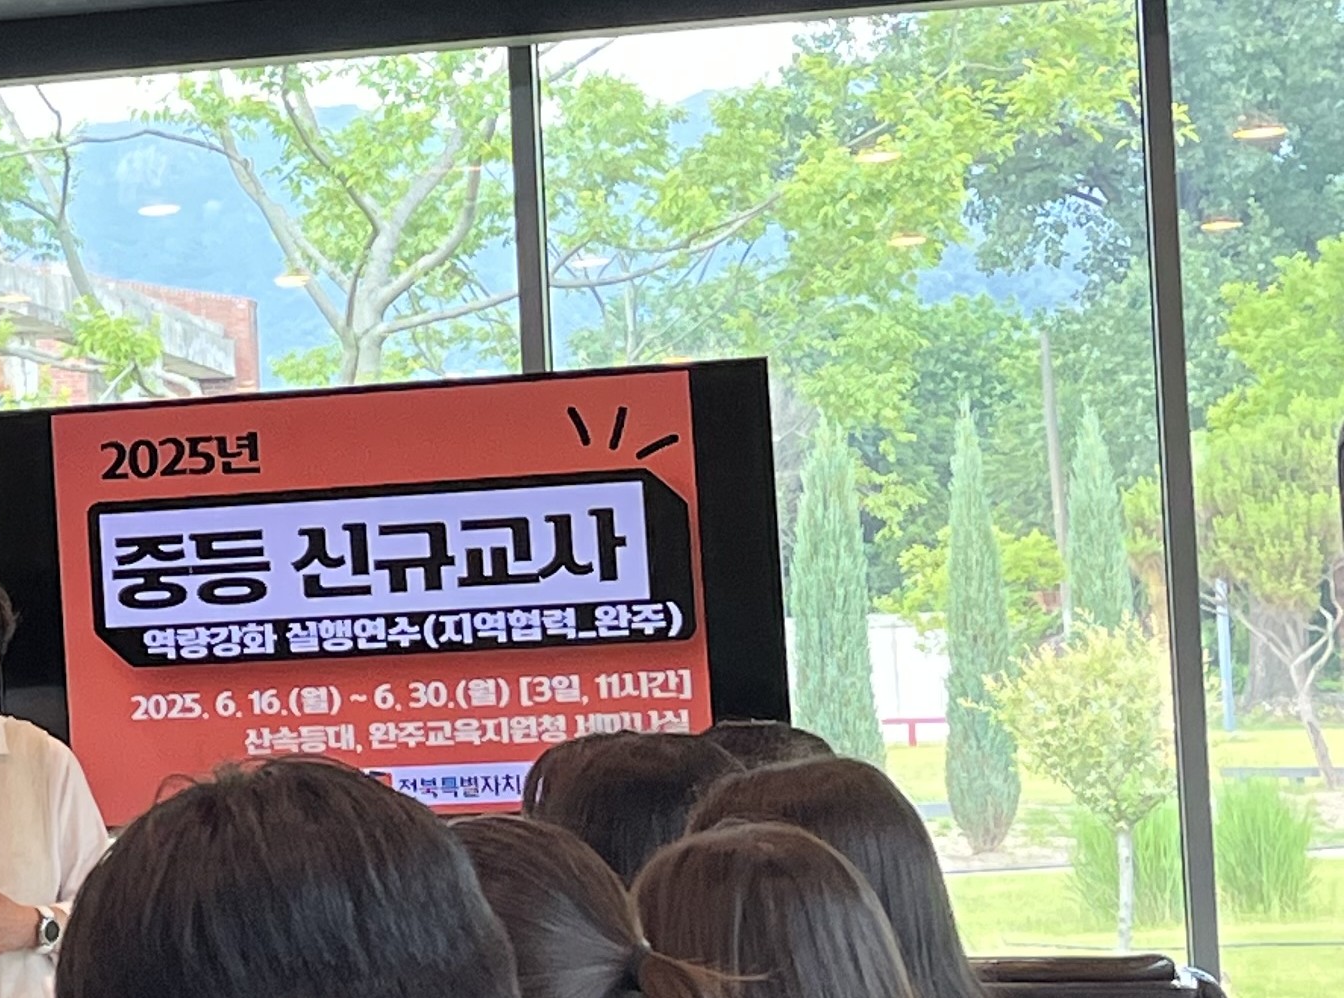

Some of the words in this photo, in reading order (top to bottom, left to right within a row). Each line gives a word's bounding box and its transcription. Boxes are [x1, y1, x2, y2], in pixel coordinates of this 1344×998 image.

[100, 431, 261, 480] 2025년
[112, 529, 272, 609] 중등
[291, 507, 627, 599] 신규교사
[142, 621, 278, 660] 역량강화
[286, 601, 683, 653] 실행연수(지역협력_완주)
[130, 692, 210, 720] 2025.
[214, 690, 243, 718] 6.
[248, 685, 342, 717] 16.(월)
[373, 683, 402, 711] 6.
[408, 675, 511, 709] 30.(월)
[518, 674, 590, 706] [3일,
[594, 669, 692, 700] 11시간]
[245, 722, 363, 755] 산속등대,
[368, 714, 567, 750] 완주교육지원청
